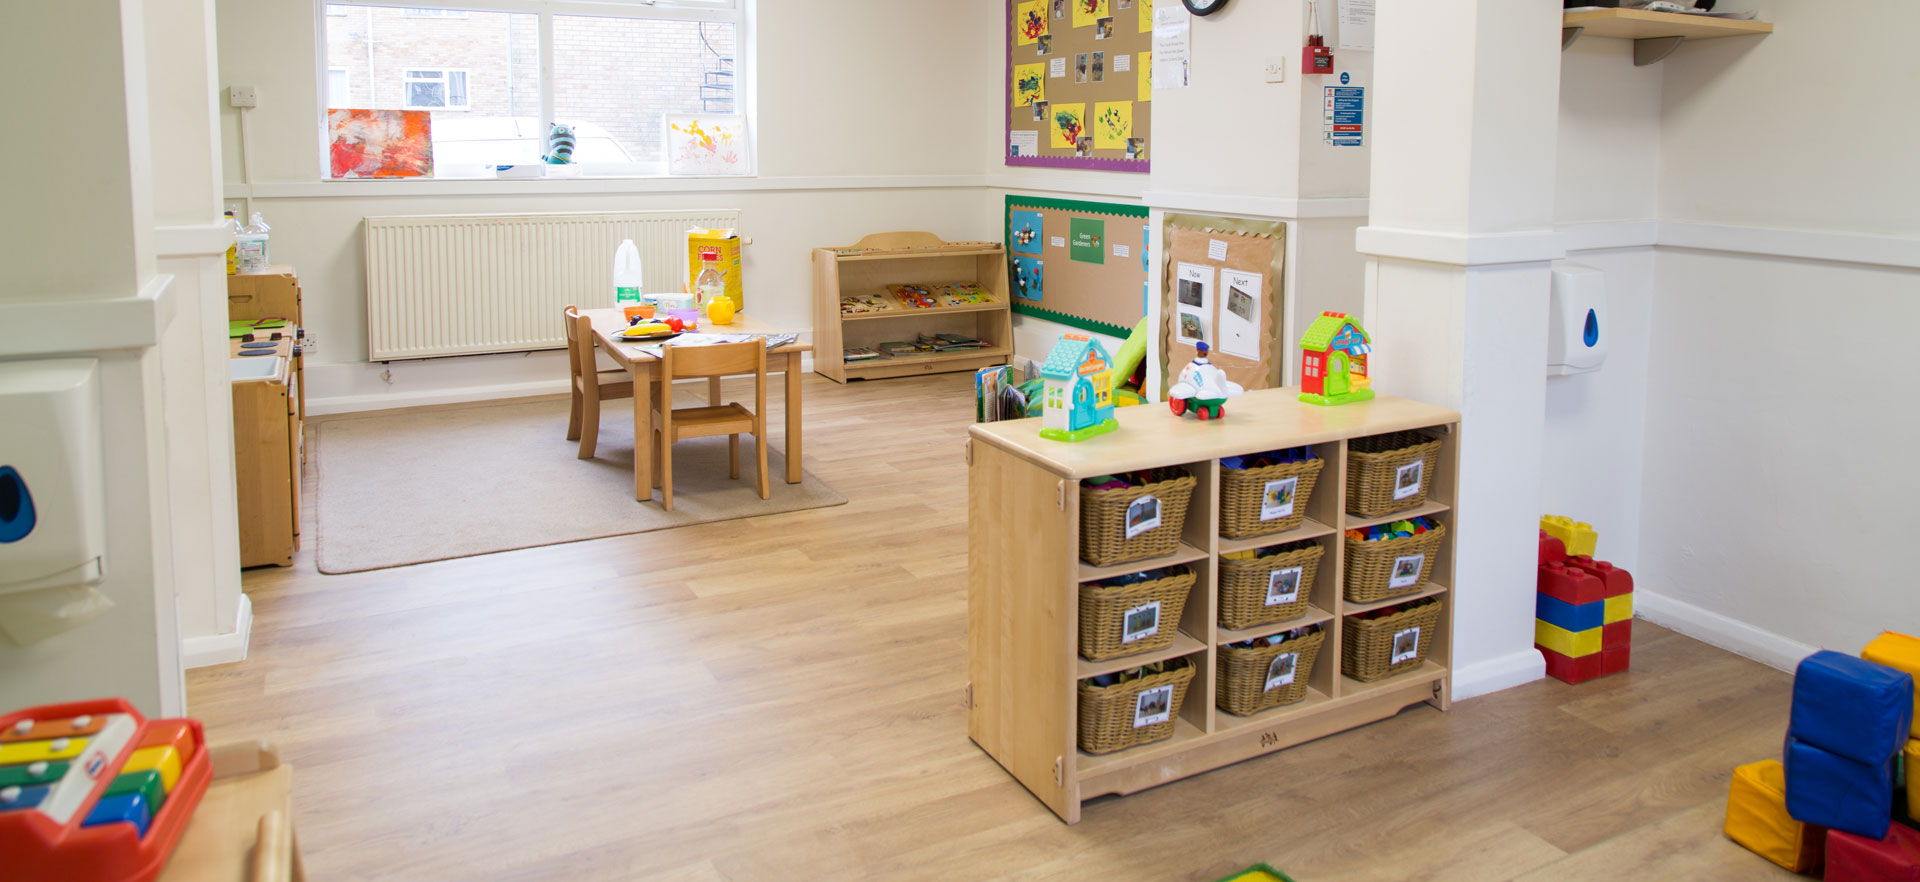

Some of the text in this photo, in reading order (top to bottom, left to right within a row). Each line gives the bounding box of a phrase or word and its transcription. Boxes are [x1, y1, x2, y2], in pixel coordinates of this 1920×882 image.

[1079, 232, 1091, 240] Green
[698, 245, 722, 254] CORN
[697, 253, 723, 261] FES
[1189, 269, 1201, 278] Now
[1233, 277, 1248, 286] Next
